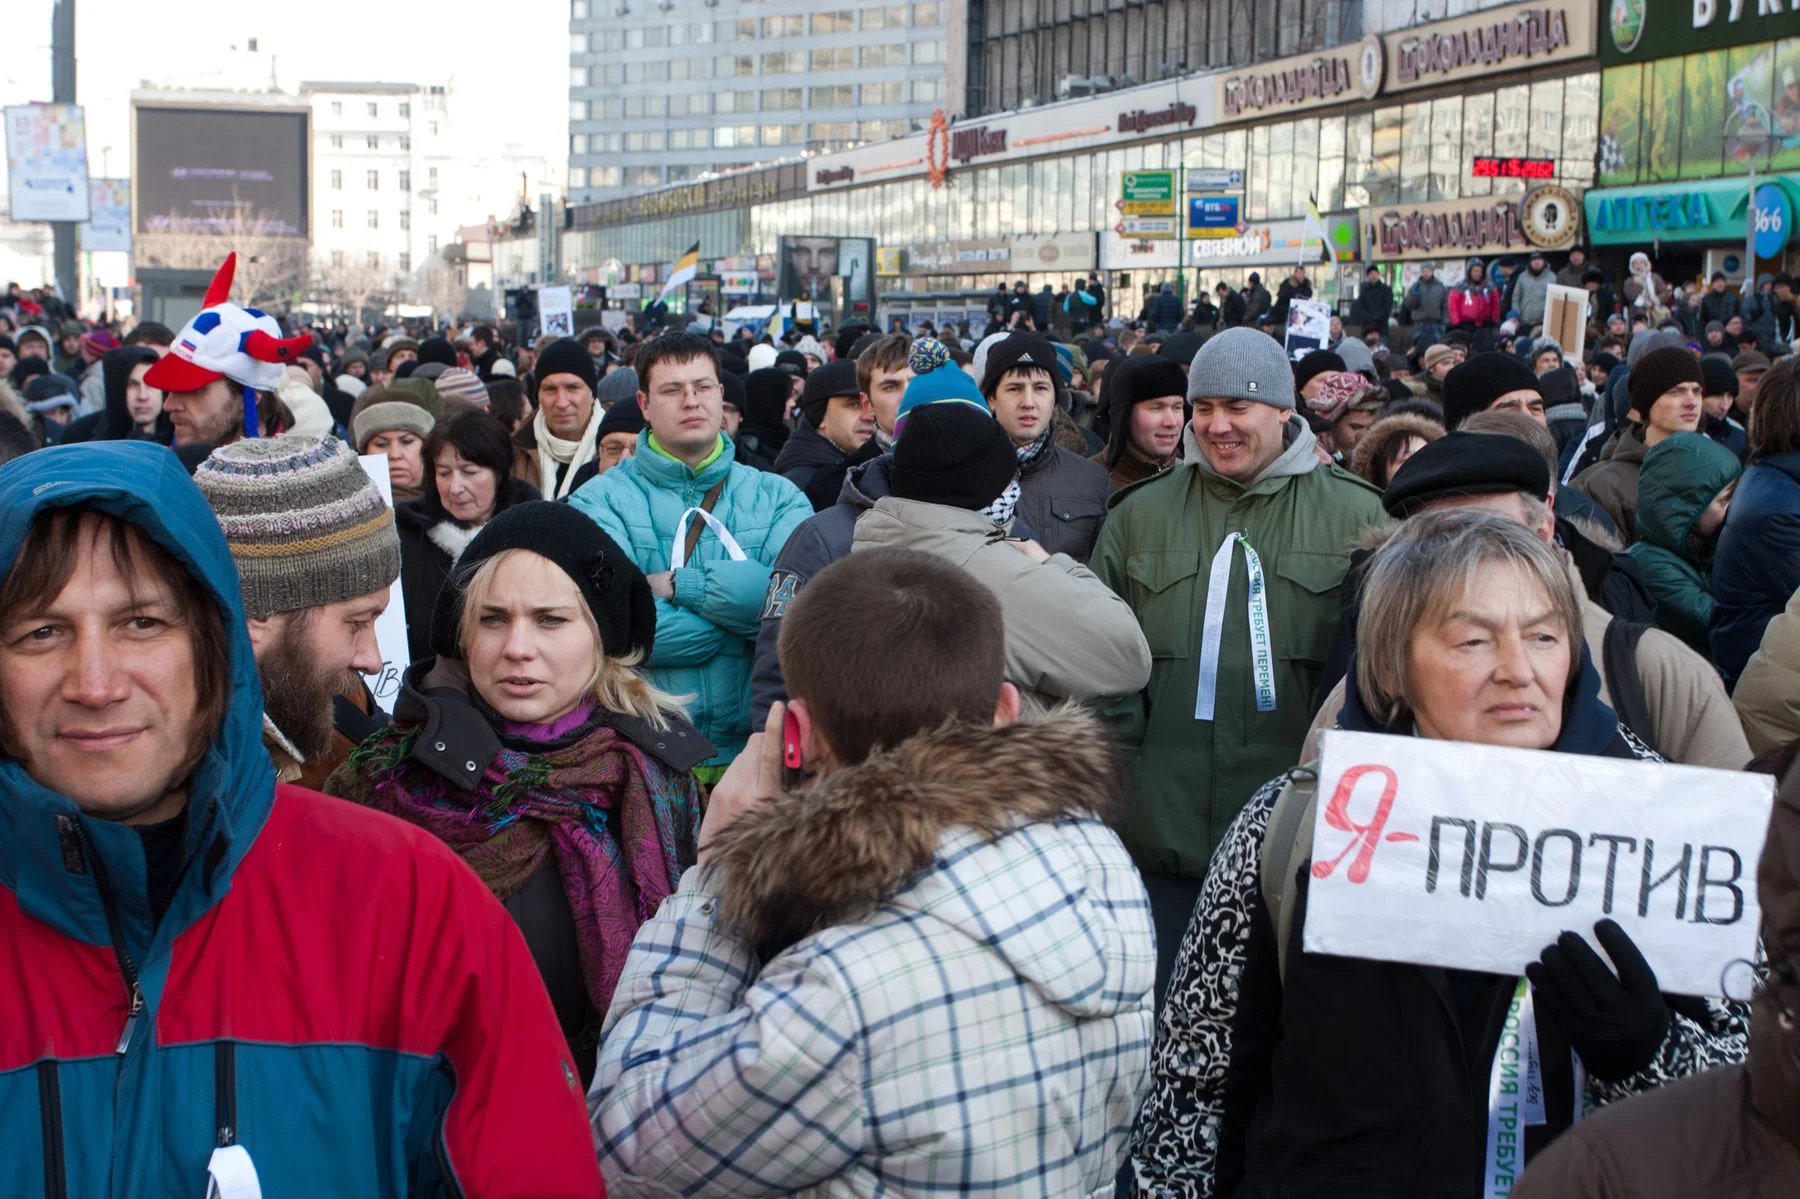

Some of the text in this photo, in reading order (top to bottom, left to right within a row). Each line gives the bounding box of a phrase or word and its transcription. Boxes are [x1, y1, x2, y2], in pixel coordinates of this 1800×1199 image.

[1397, 9, 1568, 81] ШОКОЛАДНИЦА
[1224, 57, 1350, 115] ШОКОЛАДНИЦА
[1380, 201, 1529, 254] ШОКОЛАДНИЦ
[1595, 192, 1710, 232] АПТЕКА
[1193, 230, 1261, 258] СВЯЗНОЙ
[1252, 598, 1267, 647] ТРЕБУЕТ
[1257, 649, 1273, 709] ПЕРЕМЕН!
[1425, 815, 1744, 926] ПРОТИВ
[1499, 1000, 1521, 1095] РОССИЯ
